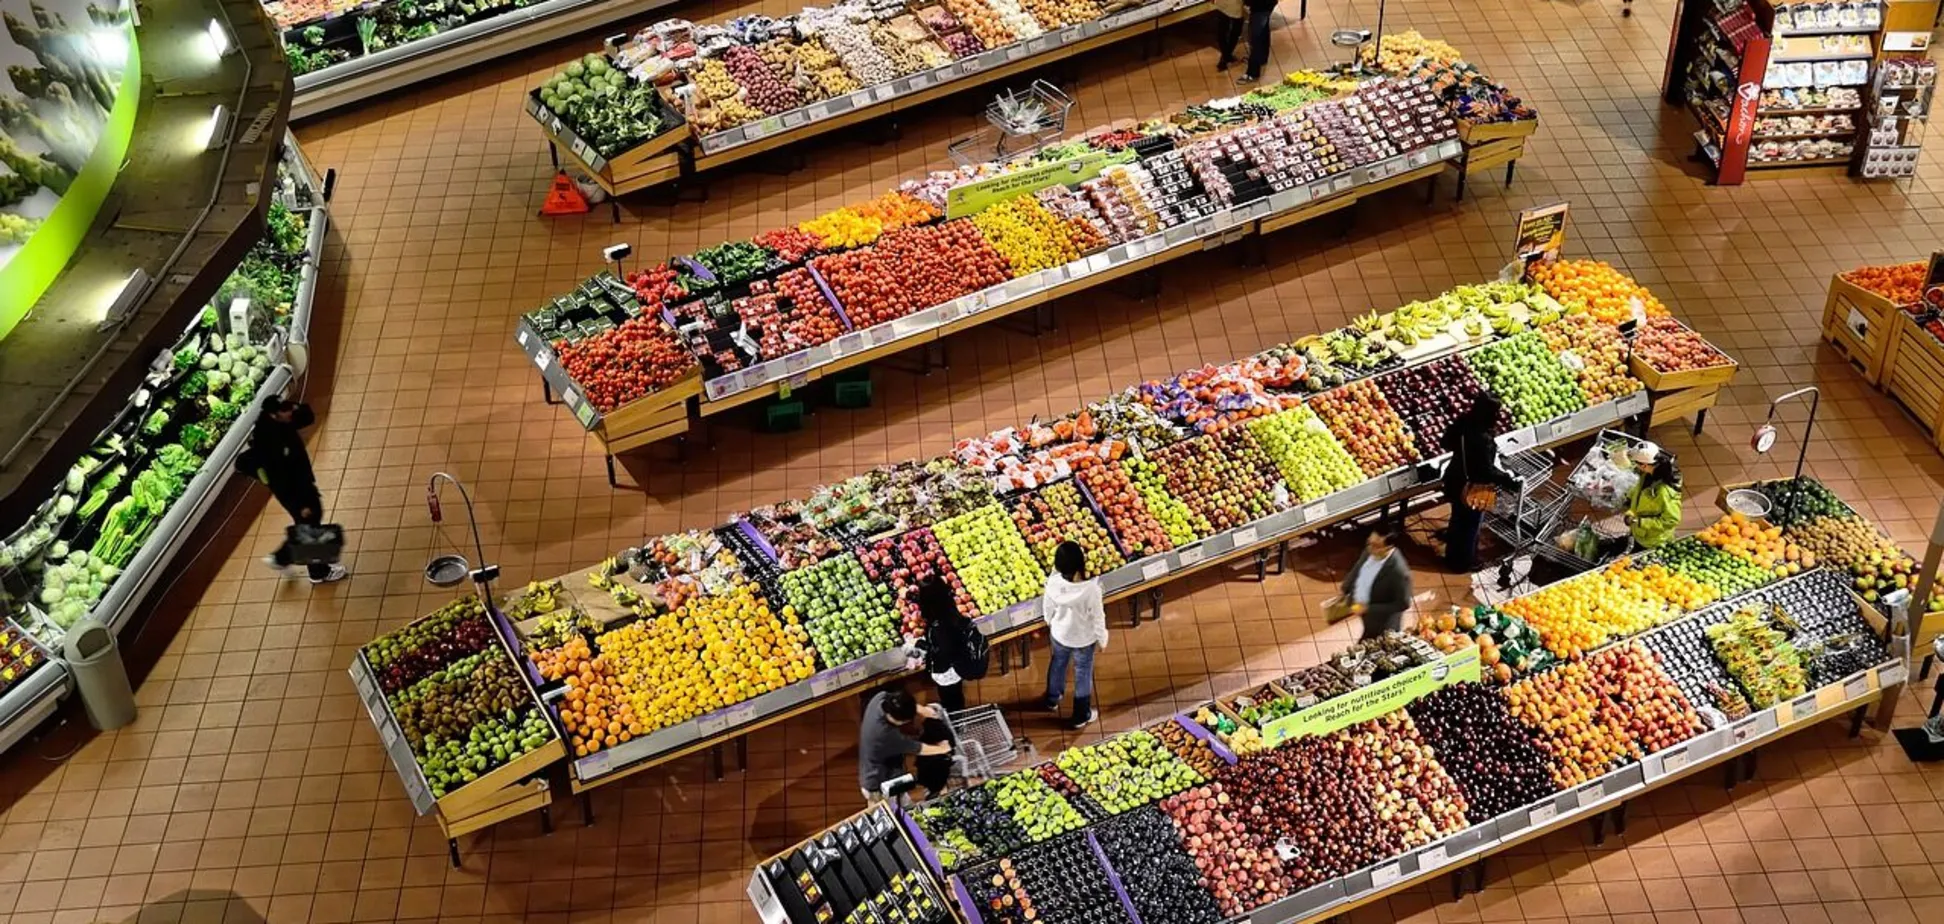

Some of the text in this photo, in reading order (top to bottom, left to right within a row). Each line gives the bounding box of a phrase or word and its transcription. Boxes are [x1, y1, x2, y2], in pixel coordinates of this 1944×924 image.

[1303, 705, 1336, 723] Looking
[1337, 700, 1349, 711] for
[1350, 686, 1391, 708] nutritious
[1391, 671, 1427, 692] choices?
[1325, 687, 1407, 722] Reach for the Stars!
